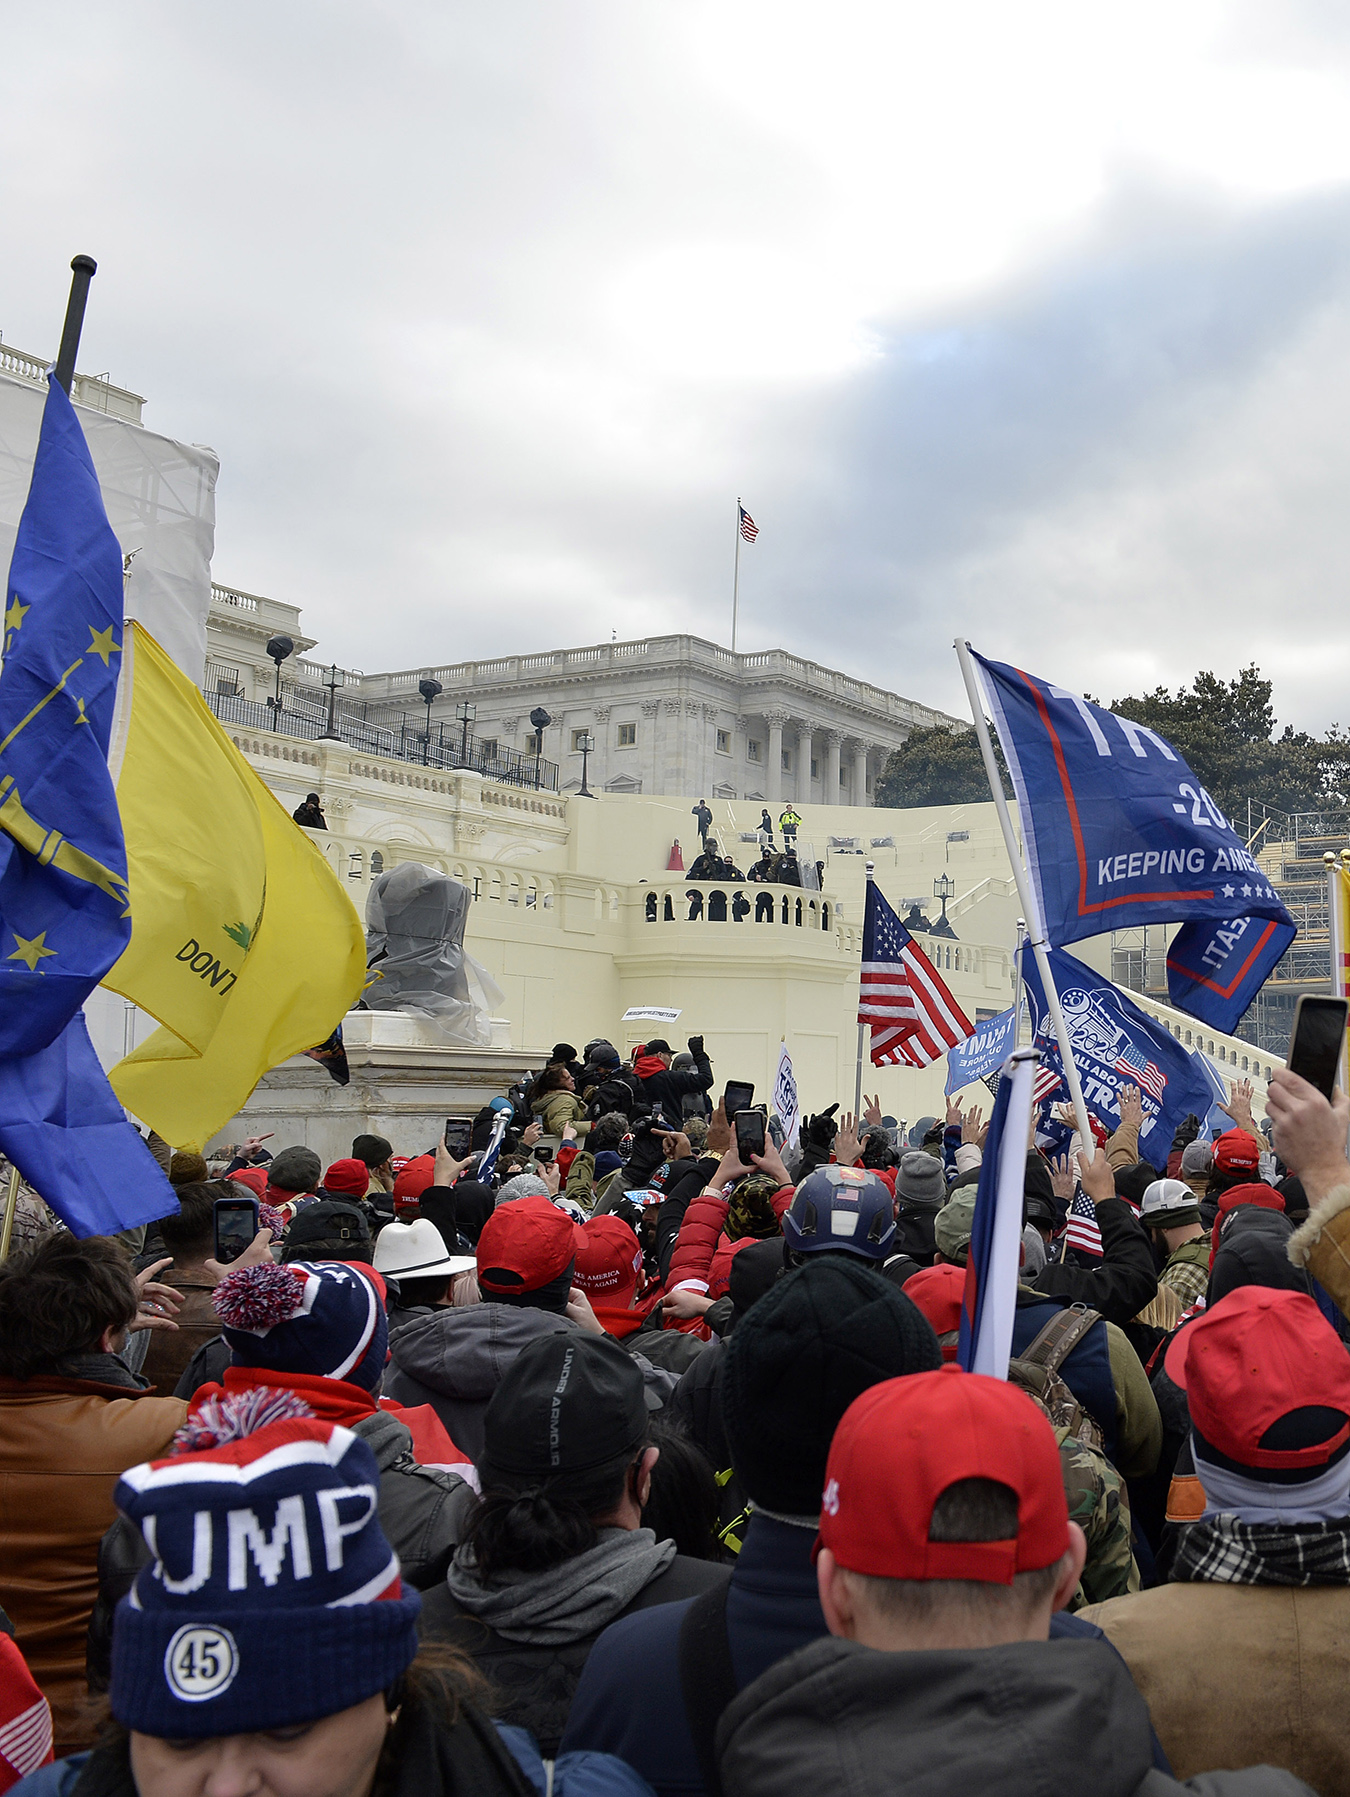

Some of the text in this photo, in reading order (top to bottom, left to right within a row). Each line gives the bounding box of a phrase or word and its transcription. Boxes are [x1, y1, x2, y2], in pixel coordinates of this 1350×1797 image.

[1098, 847, 1205, 885] KEEPING
[1070, 1026, 1119, 1063] 2020
[1073, 1053, 1090, 1071] ALL
[1140, 1095, 1161, 1116] THE
[587, 1269, 620, 1281] AMERICA
[594, 1277, 618, 1288] AGAIN
[550, 1347, 574, 1467] UNDER ARMOUR
[177, 1639, 221, 1681] 45
